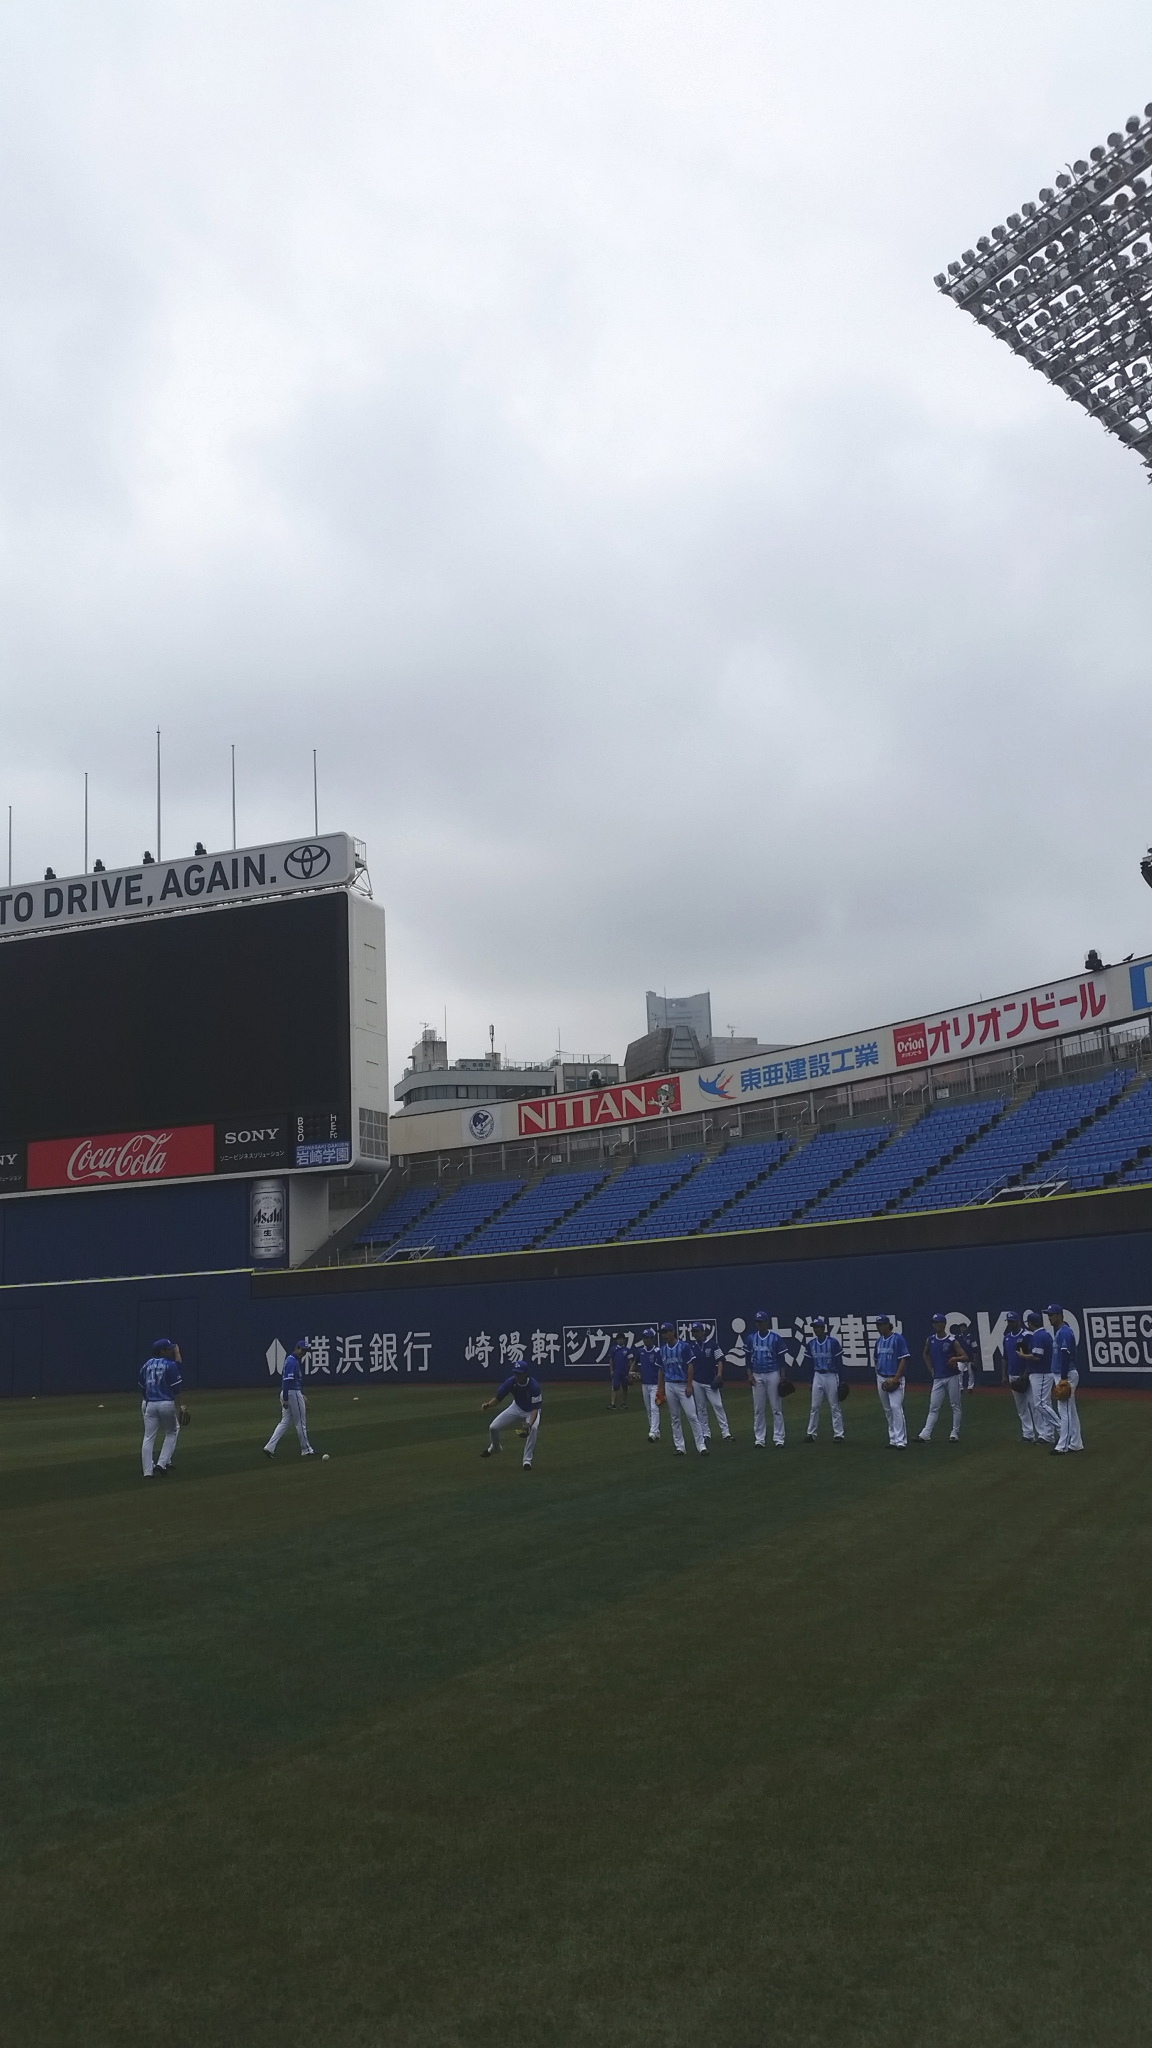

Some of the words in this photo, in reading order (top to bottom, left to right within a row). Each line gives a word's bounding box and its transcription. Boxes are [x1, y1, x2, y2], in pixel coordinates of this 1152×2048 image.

[0, 891, 34, 925] TO
[44, 873, 154, 919] DRIVE,
[160, 853, 278, 901] AGAIN.
[927, 981, 1107, 1057] オリオンビール
[740, 1041, 880, 1092] 東亜建設工業
[520, 1085, 646, 1135] NITTAN
[219, 1150, 285, 1162] ソニービジネスソリューション
[224, 1128, 280, 1145] SONY
[296, 1146, 349, 1166] 岩崎学園
[254, 1207, 282, 1225] Asahi
[301, 1331, 433, 1376] 横浜銀行
[464, 1328, 562, 1369] 崎陽軒
